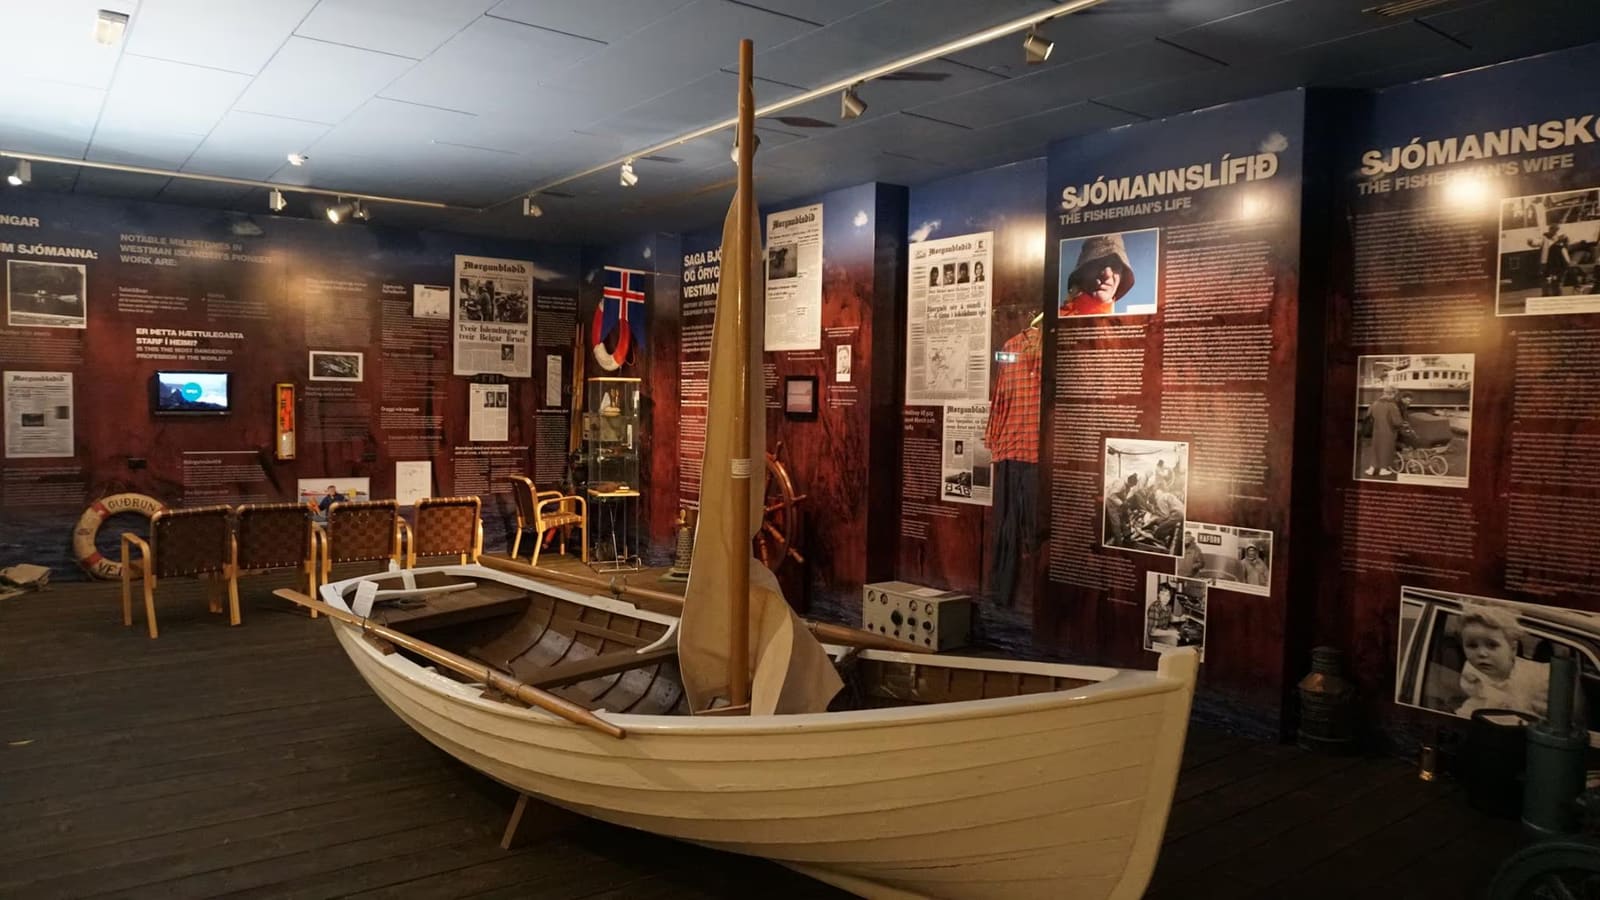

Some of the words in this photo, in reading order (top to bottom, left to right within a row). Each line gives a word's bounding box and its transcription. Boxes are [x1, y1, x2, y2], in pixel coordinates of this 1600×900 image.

[1361, 114, 1600, 176] SJÓMANNSK
[1062, 152, 1278, 210] SJÓMANNSLÍFIÐ
[1358, 179, 1391, 195] THE
[1395, 161, 1519, 191] FISHEAN'S
[1523, 153, 1575, 173] WIFE
[1059, 211, 1081, 226] THE
[1083, 200, 1162, 223] FISHERMAN'S
[1164, 196, 1192, 211] LIFE
[0, 214, 40, 228] NGAR
[120, 233, 167, 245] NOTABLE
[232, 243, 243, 251] IN
[17, 244, 98, 260] SJÓMANNA:
[120, 244, 172, 256] WESTMAN
[120, 255, 152, 265] WORK
[683, 252, 706, 267] SAGA
[683, 269, 696, 283] OG
[135, 328, 149, 336] ER
[135, 337, 163, 345] STARF
